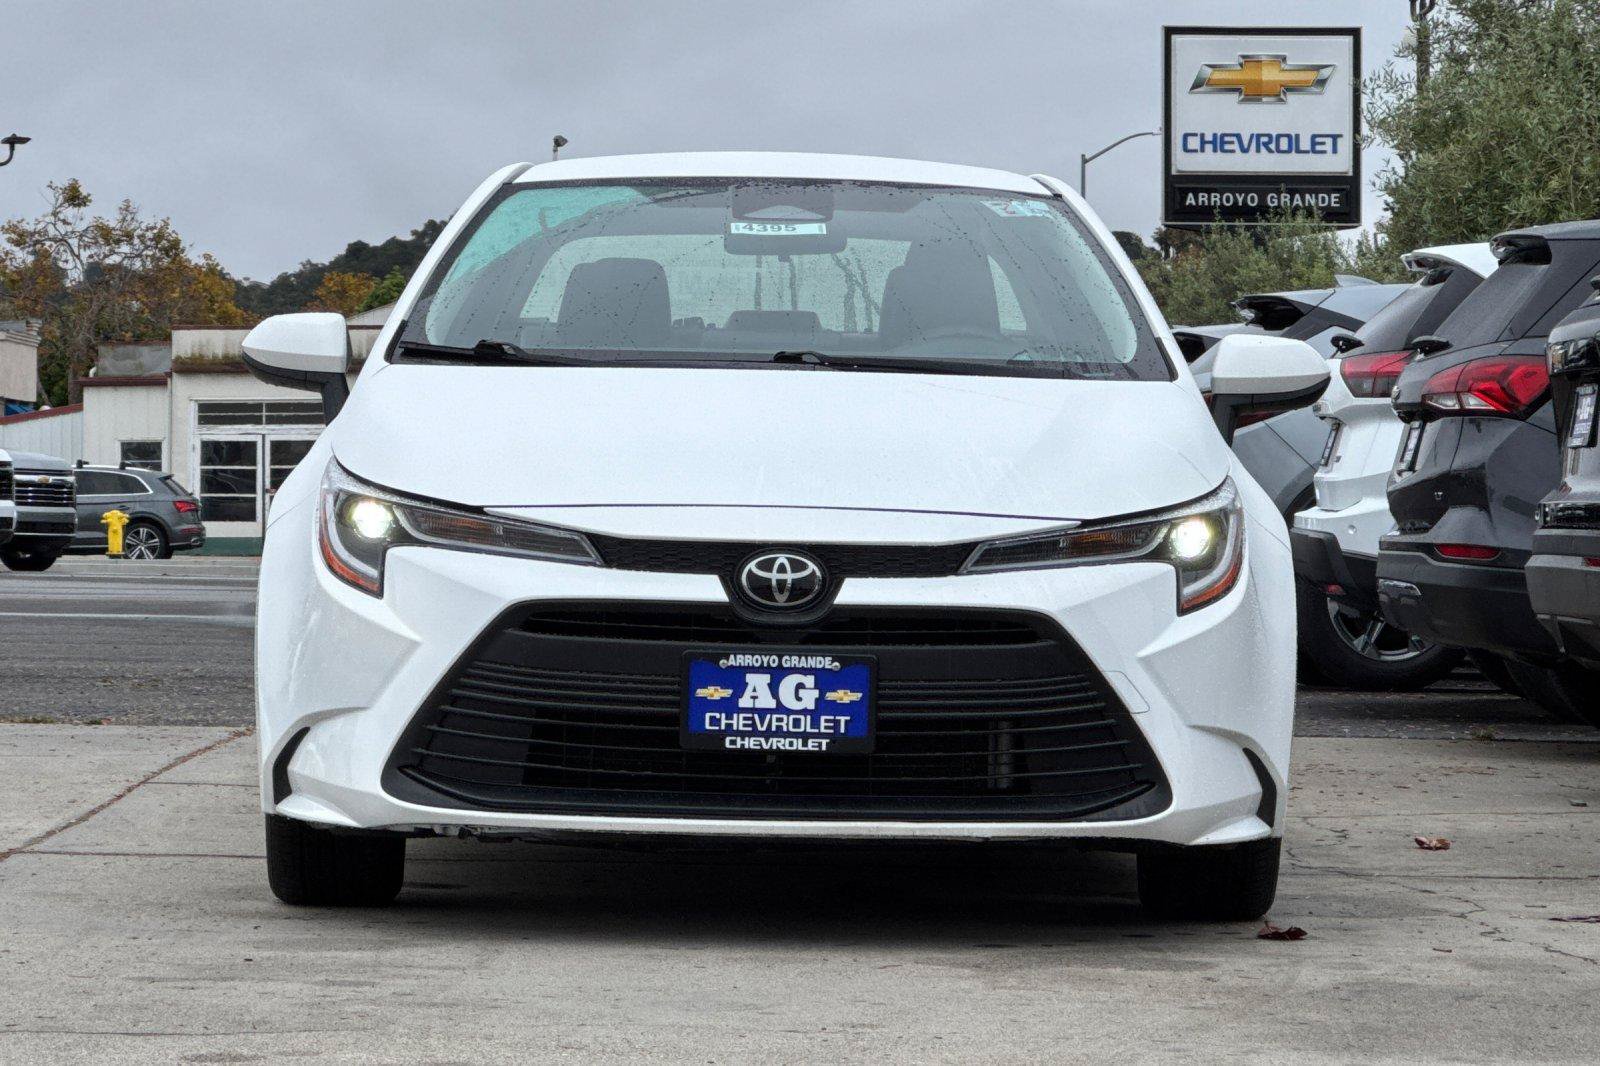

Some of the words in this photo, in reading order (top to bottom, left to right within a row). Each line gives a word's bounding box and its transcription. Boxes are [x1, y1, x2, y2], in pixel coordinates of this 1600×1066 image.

[1182, 132, 1344, 155] CHEVROLET
[1185, 192, 1259, 207] ARROYO
[1266, 192, 1341, 207] GRANDE
[742, 223, 797, 232] 4395
[727, 654, 779, 668] ARROYO
[781, 655, 833, 669] GRANDE
[738, 673, 819, 711] AG
[704, 712, 851, 734] CHEVROLET
[724, 736, 831, 751] CHEVROLET
